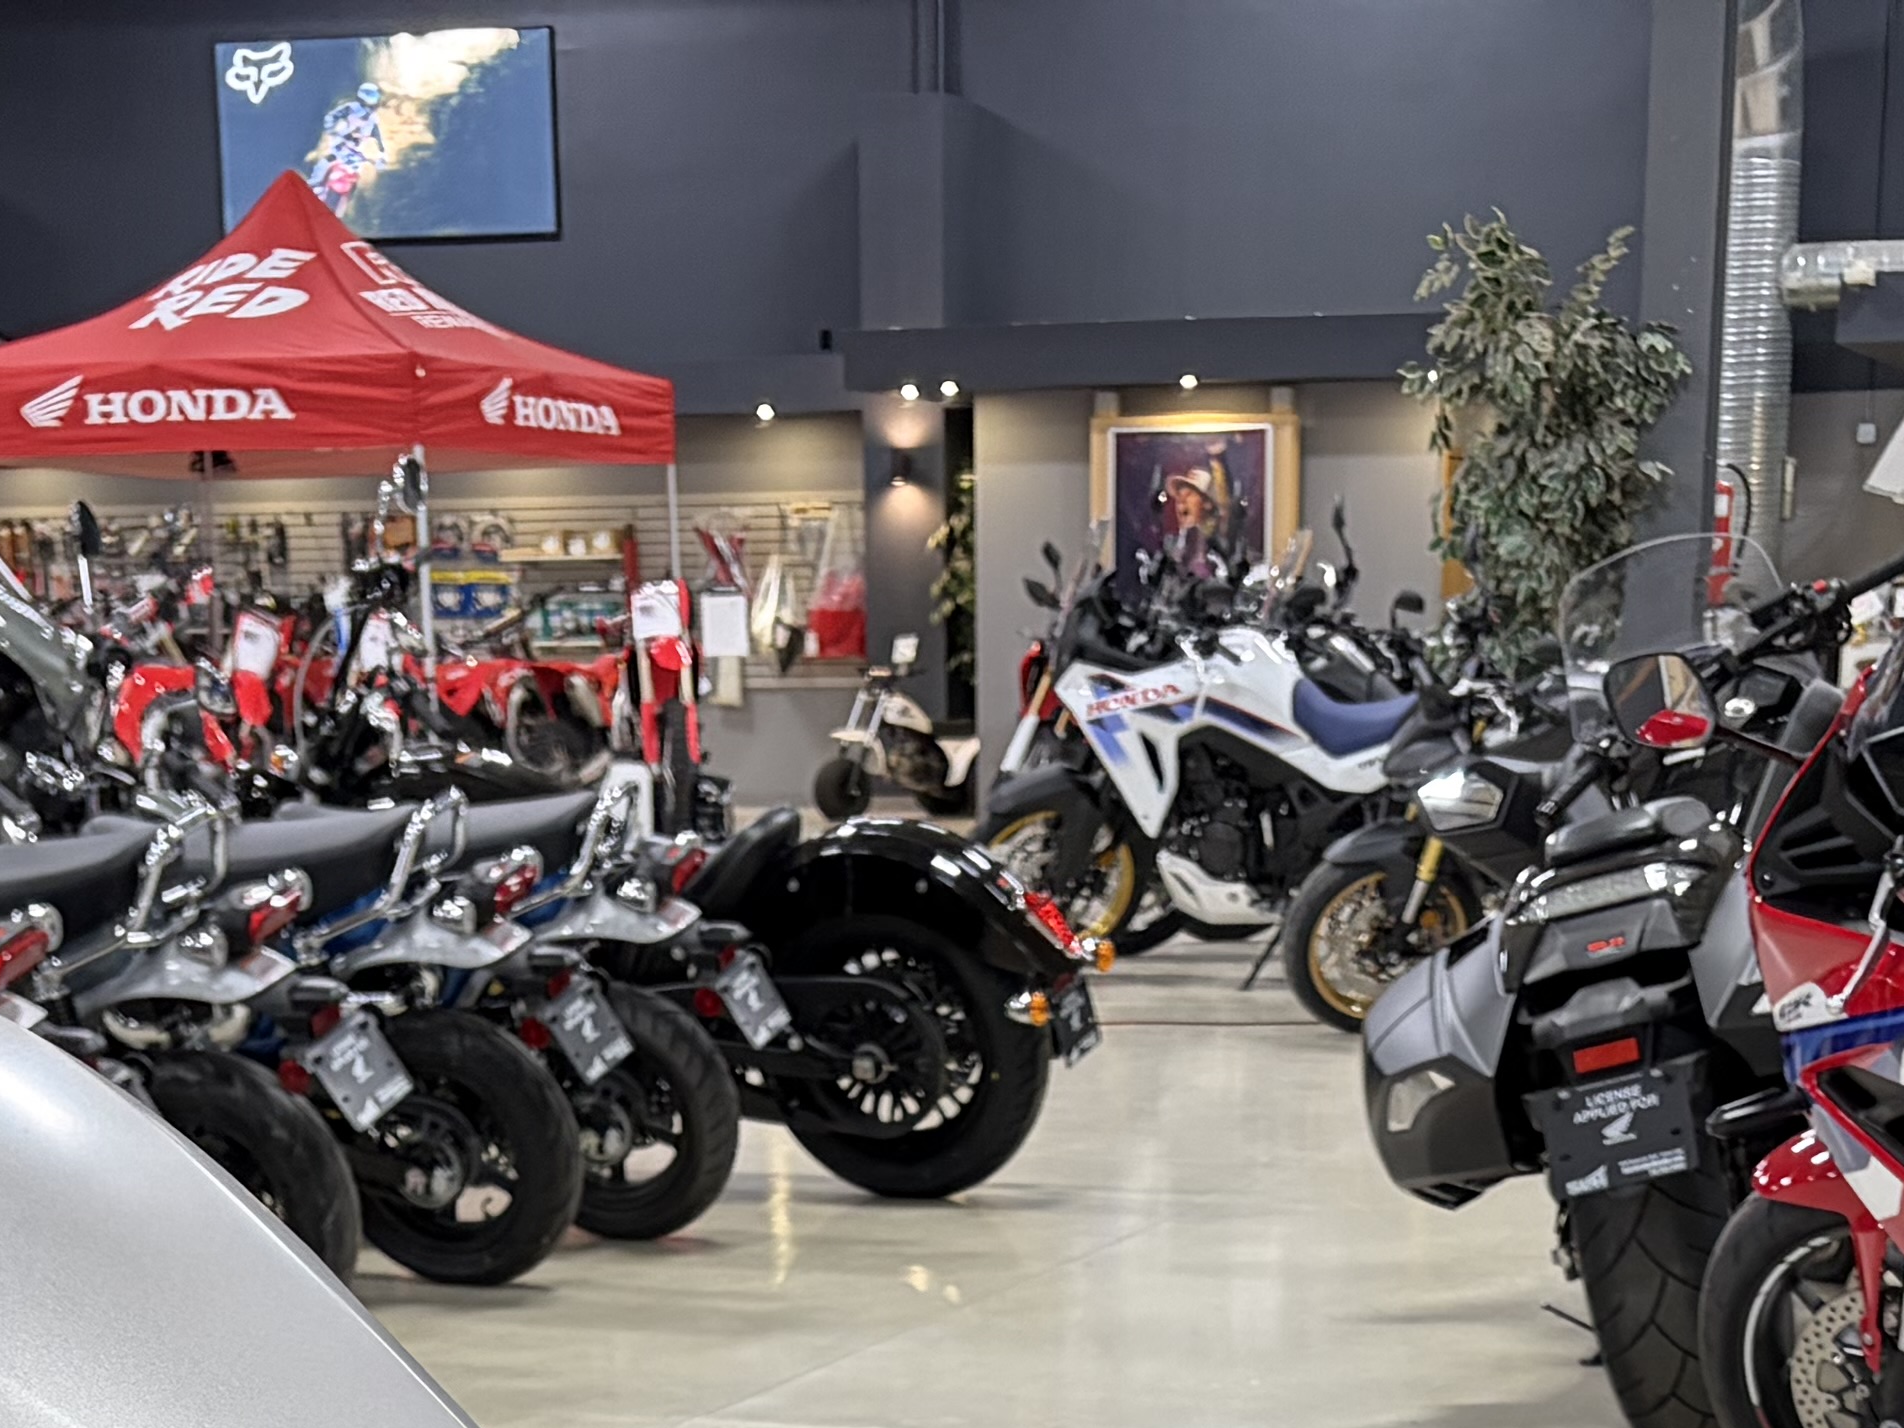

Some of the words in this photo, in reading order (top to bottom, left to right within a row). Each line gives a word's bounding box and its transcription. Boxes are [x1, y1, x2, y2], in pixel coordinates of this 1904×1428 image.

[128, 283, 310, 331] RED
[83, 388, 296, 425] HONDA
[512, 395, 621, 436] HONDA
